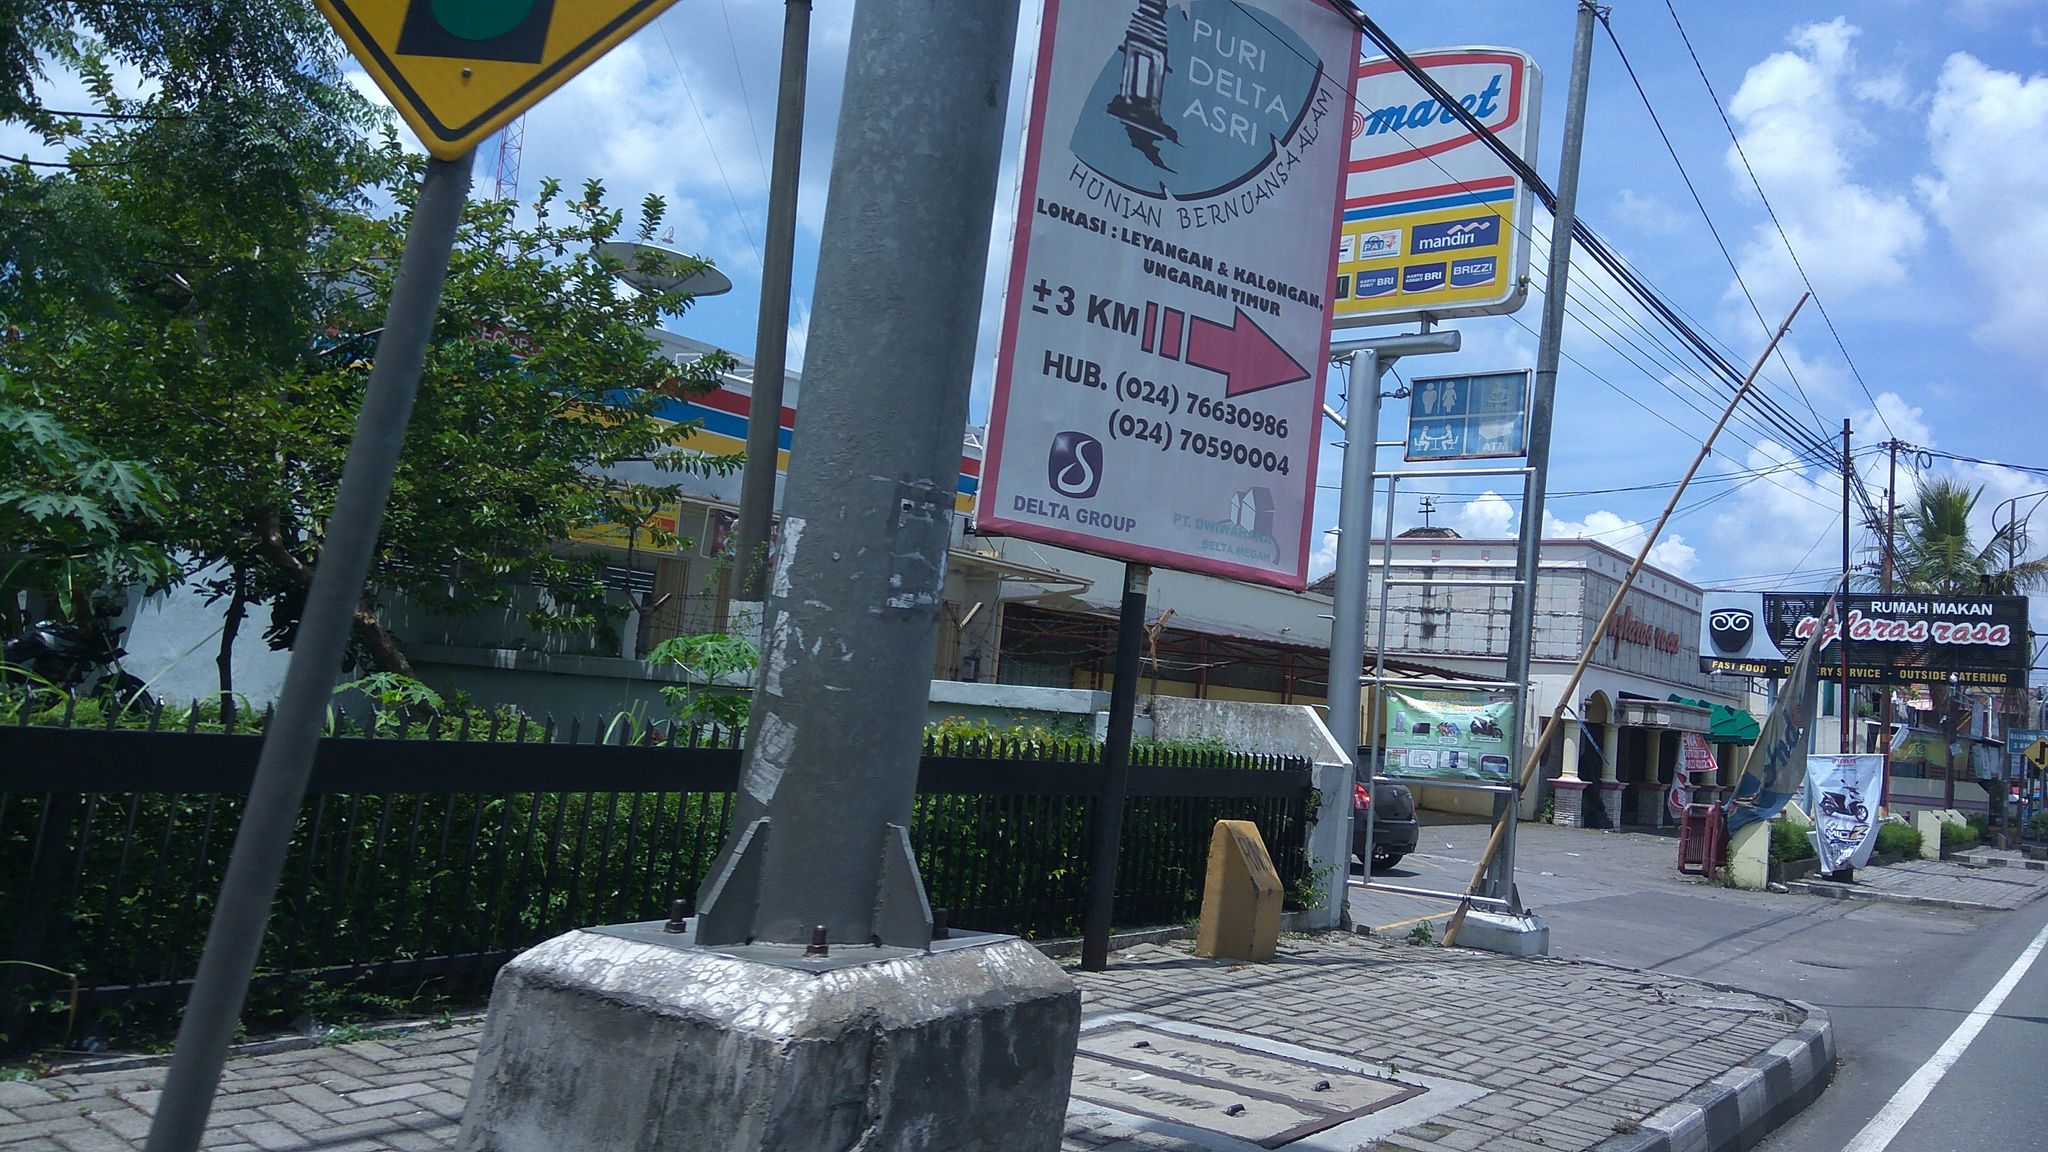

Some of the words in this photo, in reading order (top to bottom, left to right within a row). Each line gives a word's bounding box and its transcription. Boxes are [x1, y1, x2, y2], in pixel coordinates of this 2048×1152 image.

[1193, 18, 1265, 73] PURI
[1188, 56, 1289, 122] DELTA
[1182, 98, 1257, 146] ASRI
[1068, 163, 1162, 229] HUNIAN
[1176, 151, 1301, 230] BERNUANSA
[1299, 87, 1334, 154] ALAM
[1037, 197, 1107, 235] LOKASI
[1121, 227, 1213, 272] LEYANGAN
[1217, 261, 1229, 278] &
[1233, 266, 1324, 312] KALONGAN,
[1419, 232, 1474, 250] mandiri
[1376, 276, 1394, 286] BRI
[1424, 271, 1442, 281] BRI
[1453, 262, 1493, 276] BRIZZI
[1143, 258, 1228, 299] UNGARAN
[1231, 287, 1281, 317] TIMUR
[1087, 294, 1139, 336] KM
[1042, 349, 1108, 391] HUB.
[1115, 371, 1179, 415] (024)
[1186, 392, 1289, 439] 76630986
[1108, 408, 1173, 451] (024)
[1180, 429, 1290, 476] 70590004
[1482, 441, 1508, 451] ATM
[1013, 495, 1070, 521] DELTA
[1076, 508, 1136, 533] GROUP
[1173, 513, 1191, 528] PT.
[1202, 539, 1233, 554] DELTA
[1871, 601, 1928, 614] RUMAH
[1932, 602, 1993, 616] MAKAN
[1931, 621, 2011, 647] rasa
[1712, 660, 1735, 670] FAST
[1739, 663, 1767, 673] FOOD
[1836, 667, 1881, 678] SRVICE
[1900, 669, 1947, 681] OUTSIDE
